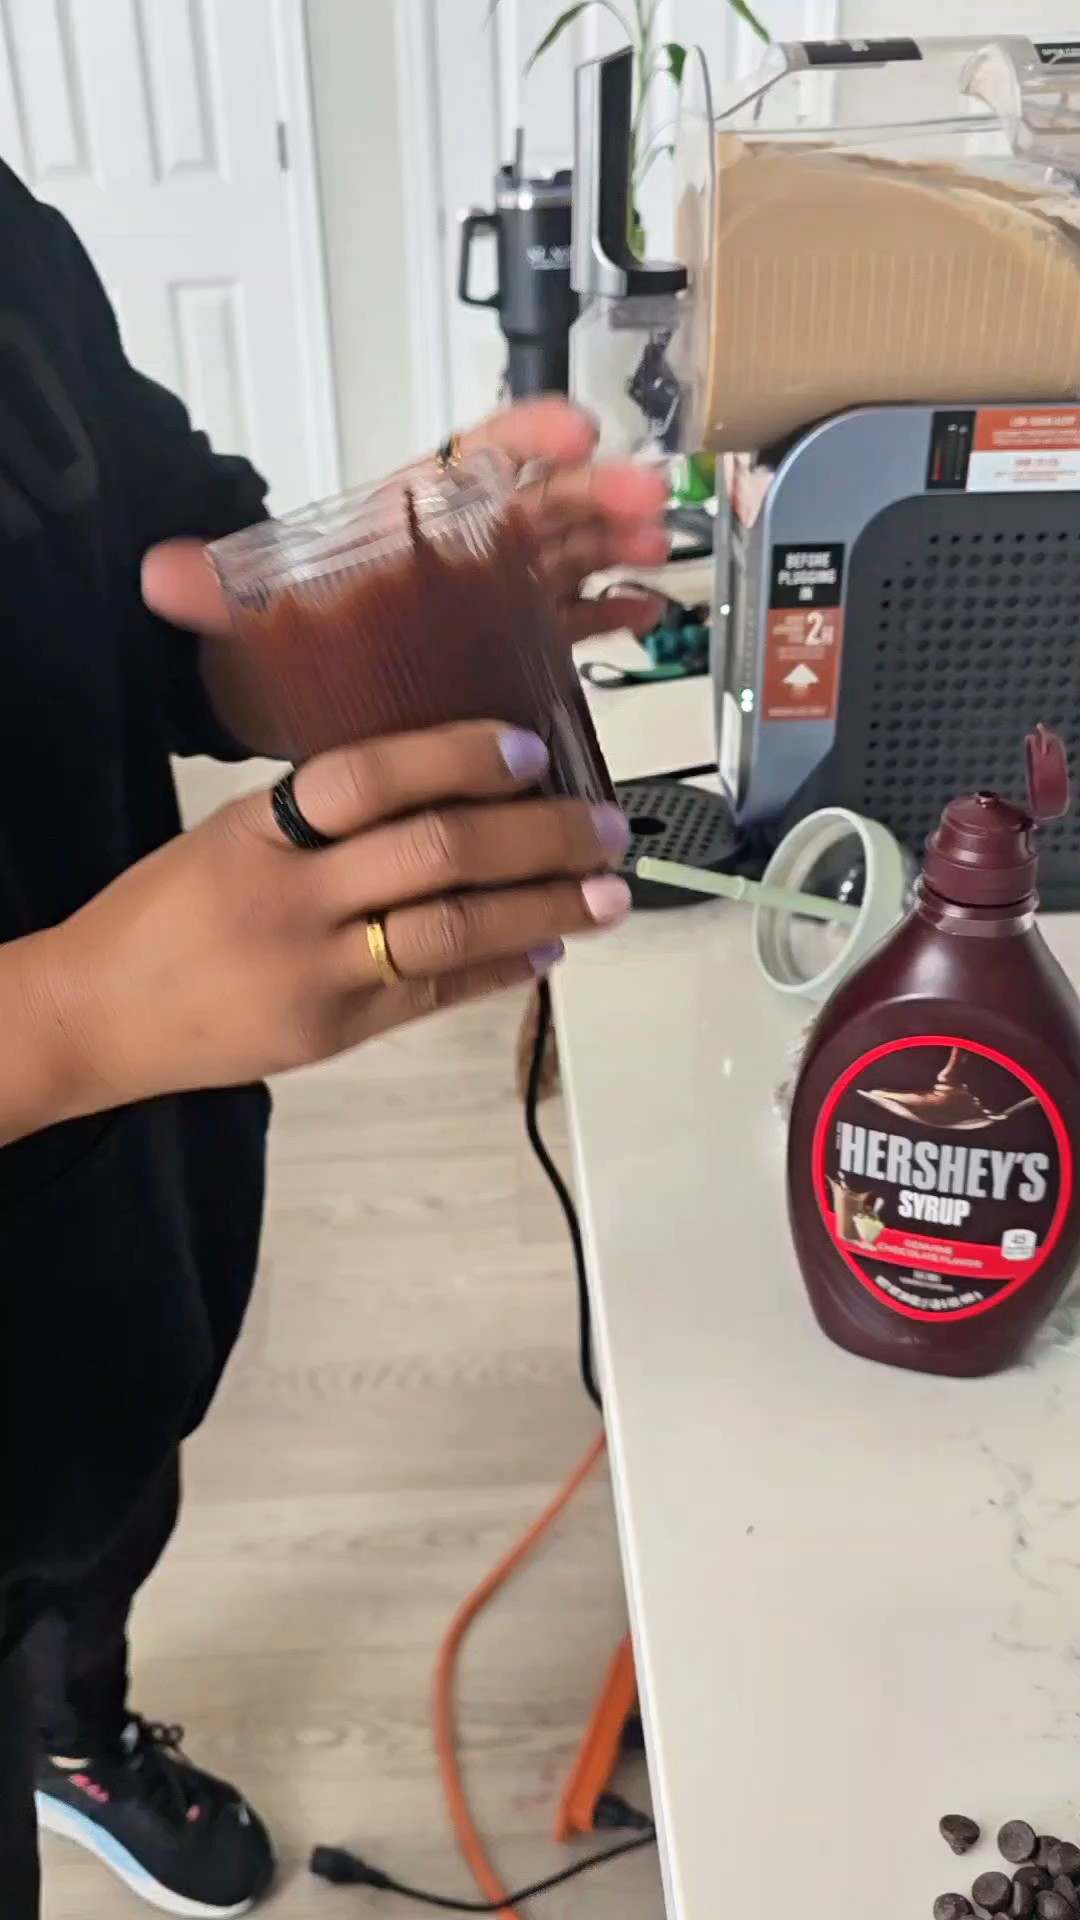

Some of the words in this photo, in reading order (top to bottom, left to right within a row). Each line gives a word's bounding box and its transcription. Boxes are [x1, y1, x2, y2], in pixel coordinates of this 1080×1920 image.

[785, 552, 831, 569] BEFORE
[840, 1122, 1049, 1202] HERSHEY'S
[898, 1189, 970, 1226] SYRUP
